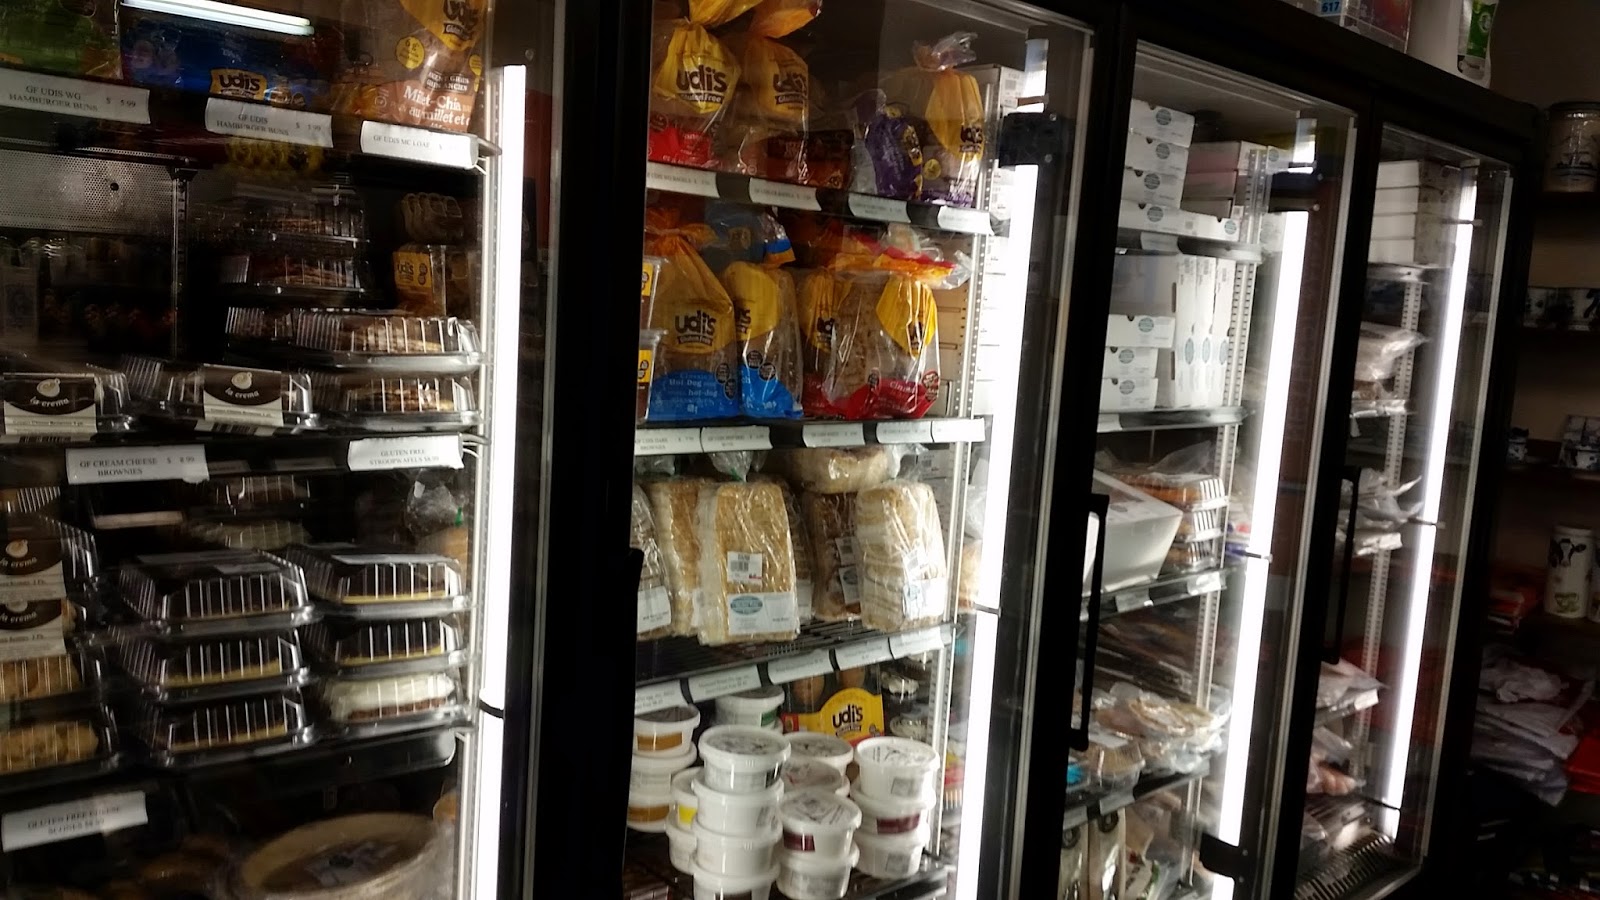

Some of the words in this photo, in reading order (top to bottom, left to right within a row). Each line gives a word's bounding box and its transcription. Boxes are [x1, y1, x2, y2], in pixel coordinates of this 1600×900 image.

[1322, 1, 1340, 12] 617
[40, 87, 64, 98] UDIS
[9, 93, 71, 109] HAMBURGER
[73, 102, 98, 112] BUNS
[249, 115, 268, 125] UDIS
[216, 120, 267, 134] HAMBURGER
[234, 390, 260, 399] crema
[41, 397, 70, 408] crema
[380, 450, 408, 458] GLUTEN
[79, 460, 91, 468] GF
[93, 459, 124, 468] CREAM
[126, 458, 157, 466] CHEESE
[97, 467, 143, 477] BROWNIES
[10, 556, 38, 568] crema
[10, 611, 38, 624] crema
